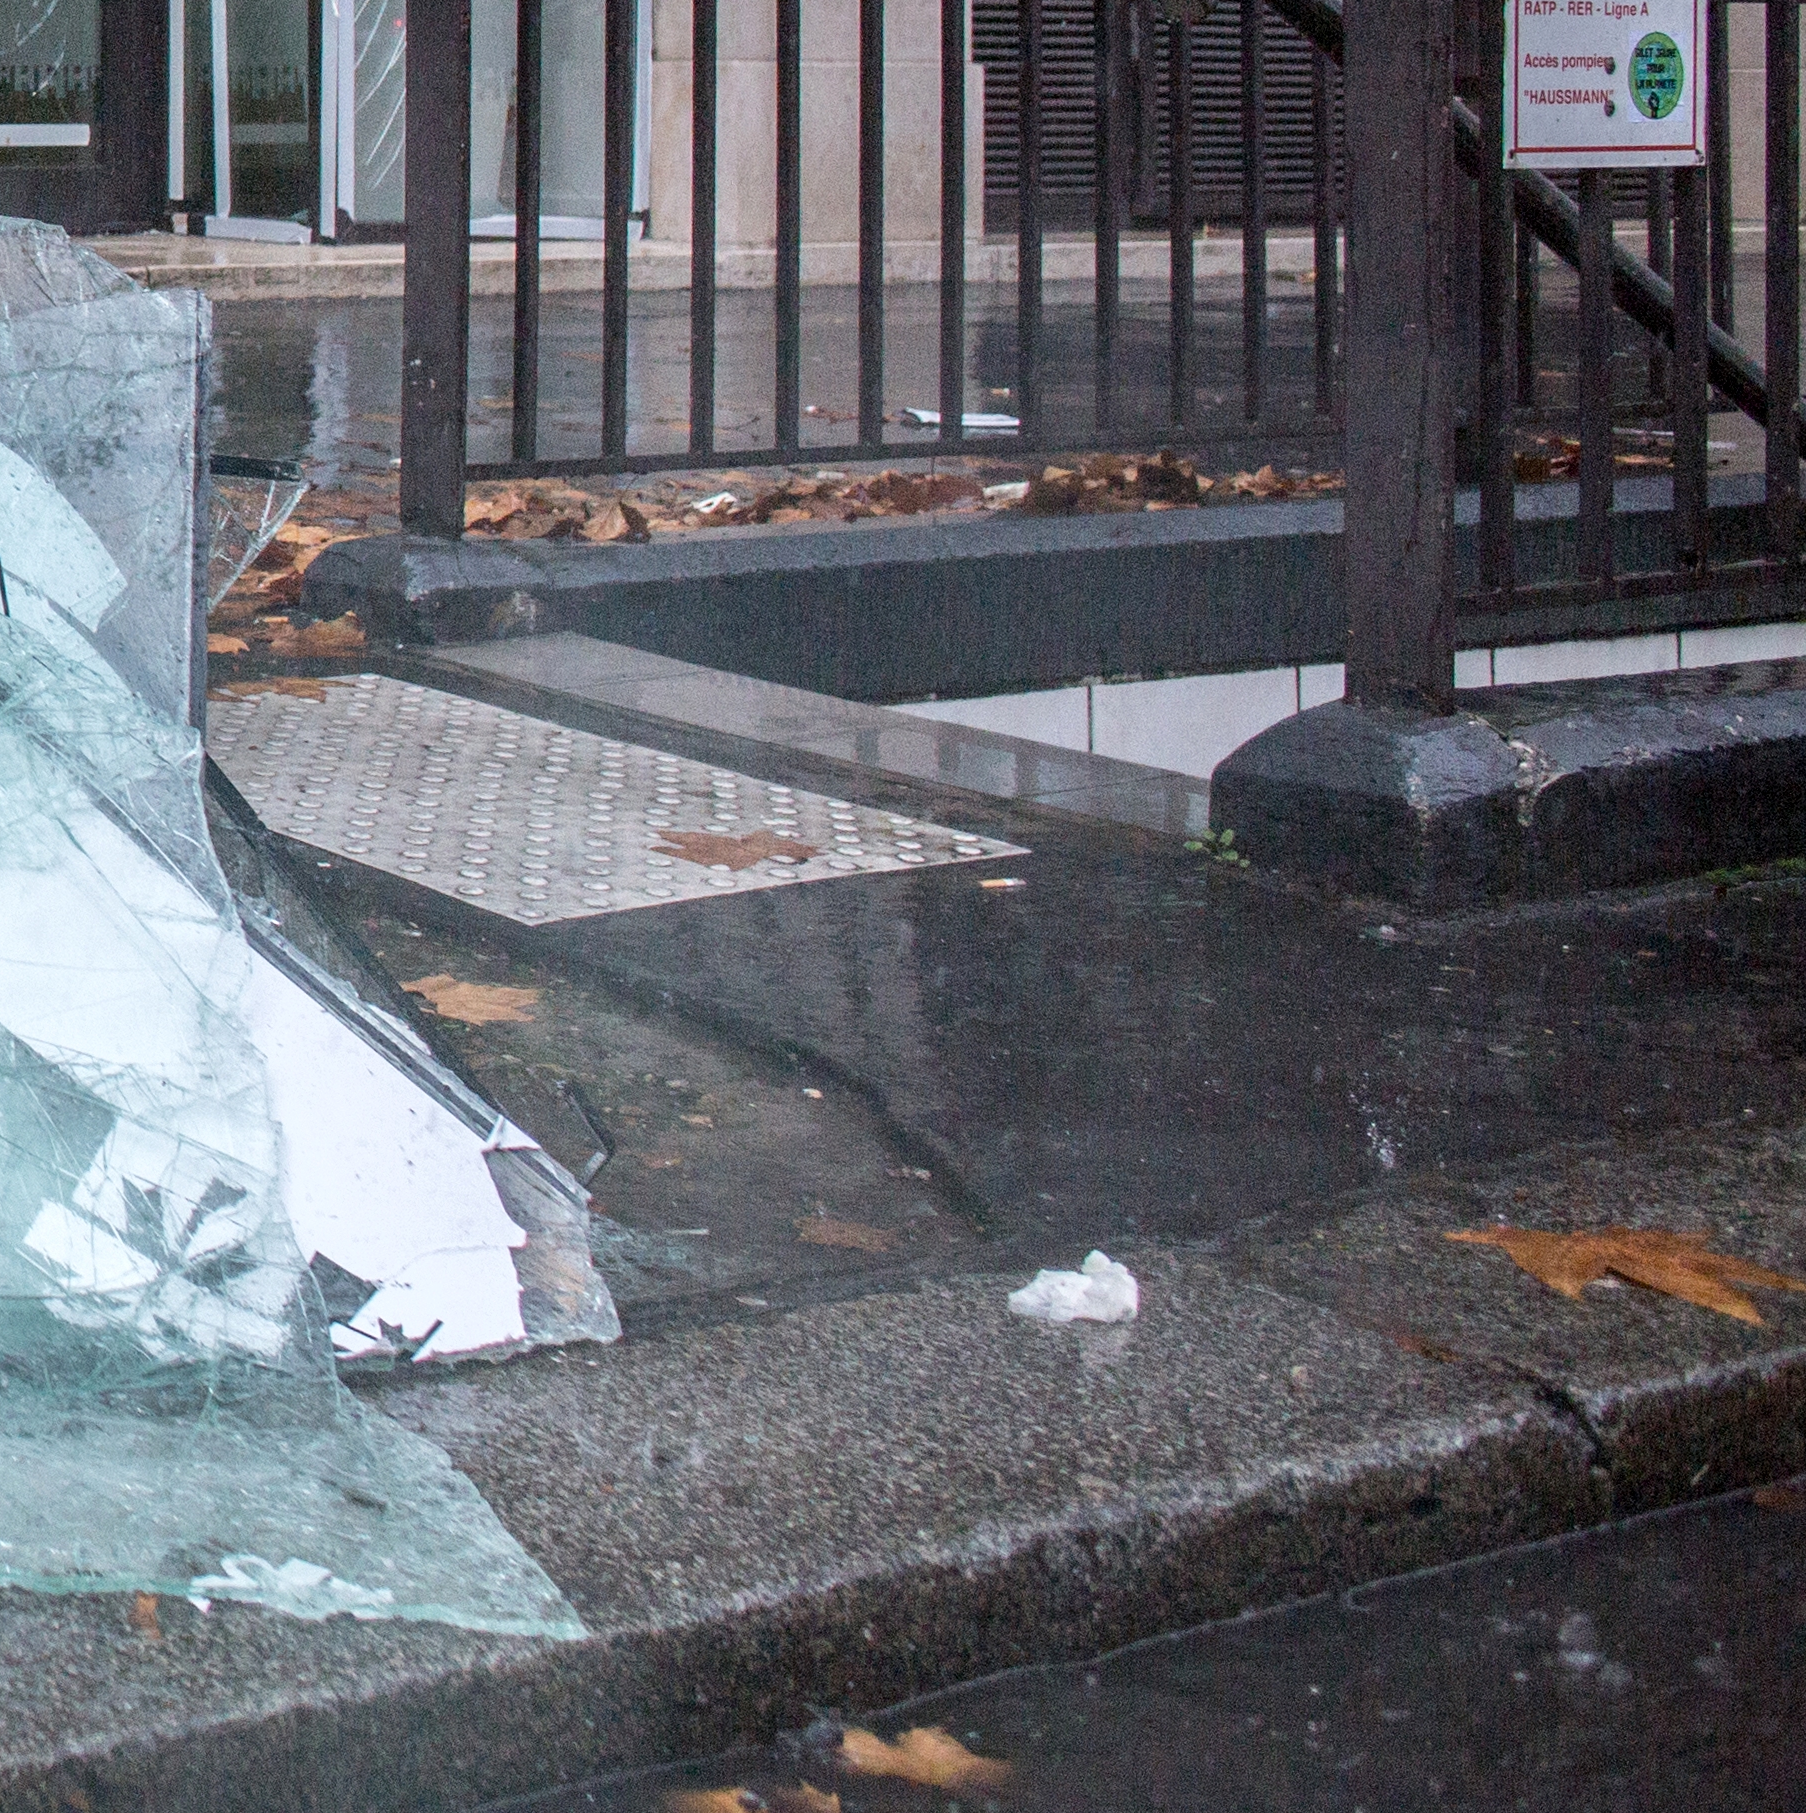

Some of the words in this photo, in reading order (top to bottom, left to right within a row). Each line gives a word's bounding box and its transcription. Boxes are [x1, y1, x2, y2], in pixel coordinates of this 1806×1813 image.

[1524, 0, 1556, 16] RATP
[1568, 1, 1593, 16] RER
[1604, 1, 1637, 20] Ligne
[1640, 1, 1649, 16] A
[1524, 53, 1559, 68] Accès
[1524, 89, 1614, 104] "HAUSSMANN"
